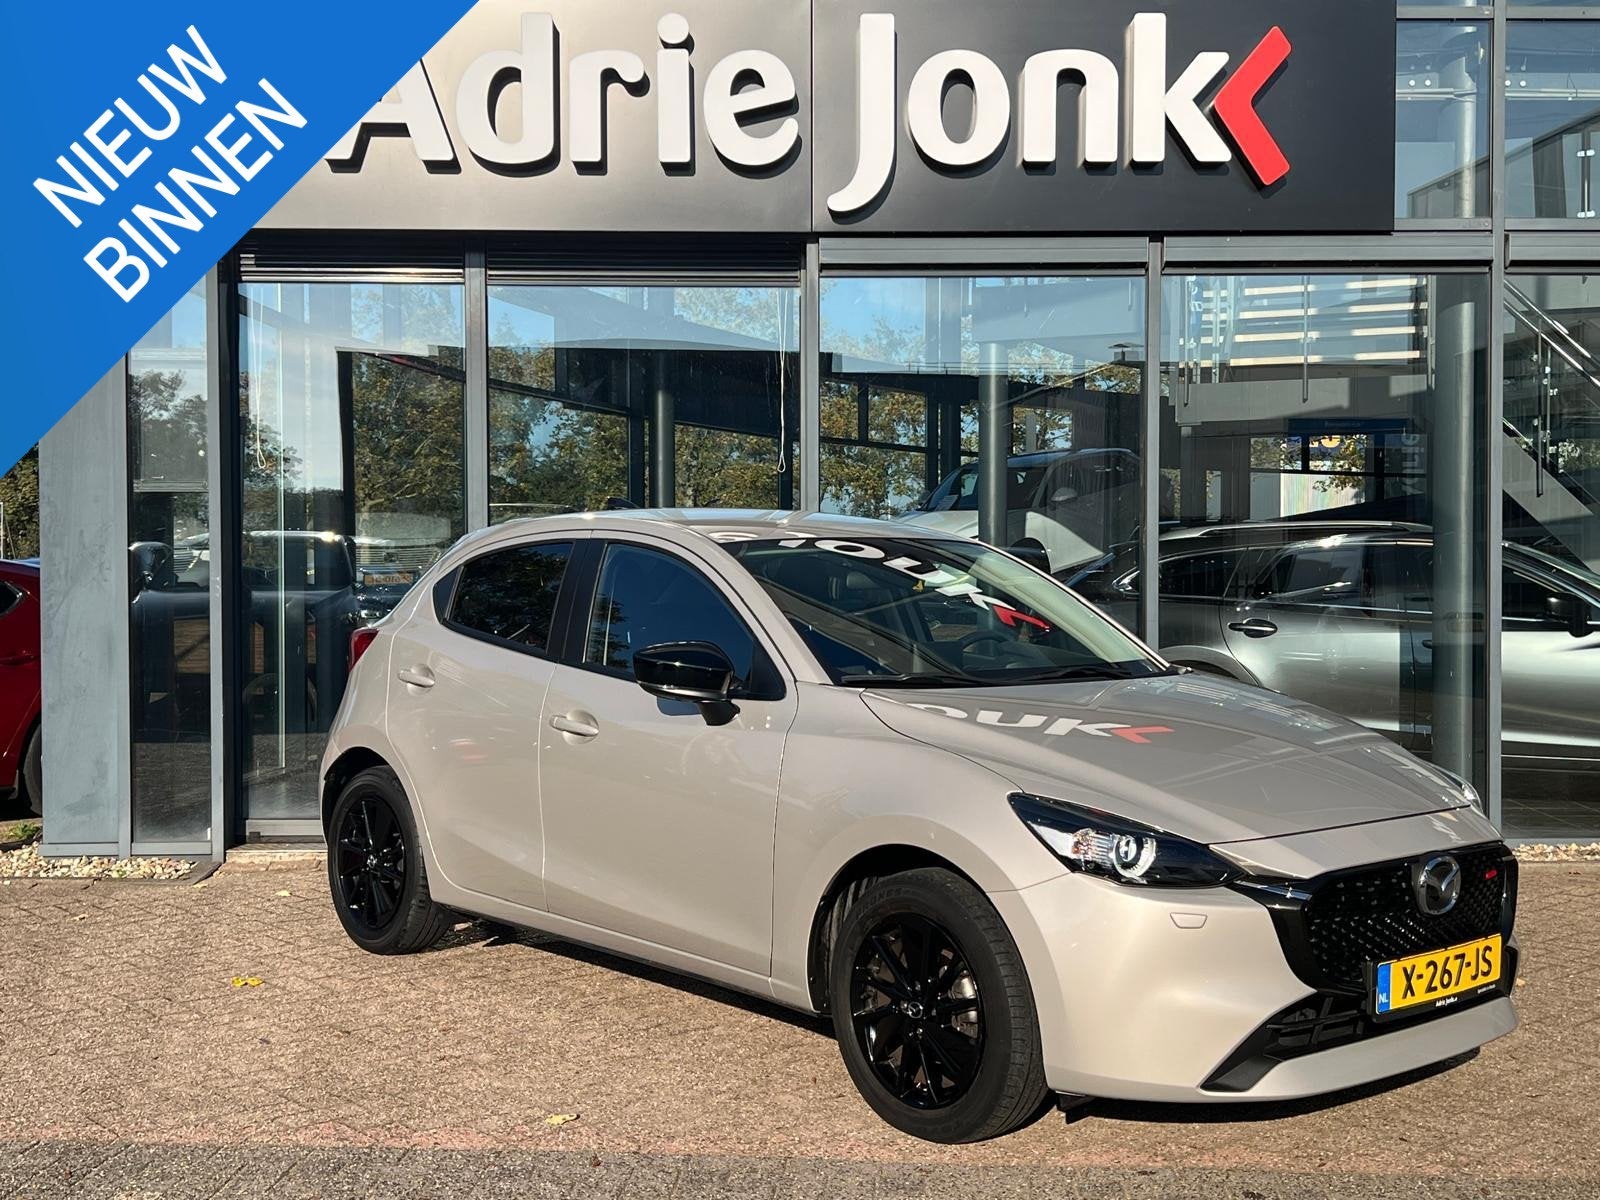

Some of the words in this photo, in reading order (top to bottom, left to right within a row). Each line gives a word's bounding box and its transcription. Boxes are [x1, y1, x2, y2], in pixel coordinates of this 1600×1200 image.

[323, 12, 801, 170] Adrie
[826, 12, 1233, 216] Jonk
[1377, 991, 1389, 1005] NL
[1401, 944, 1493, 1000] X-267-JS
